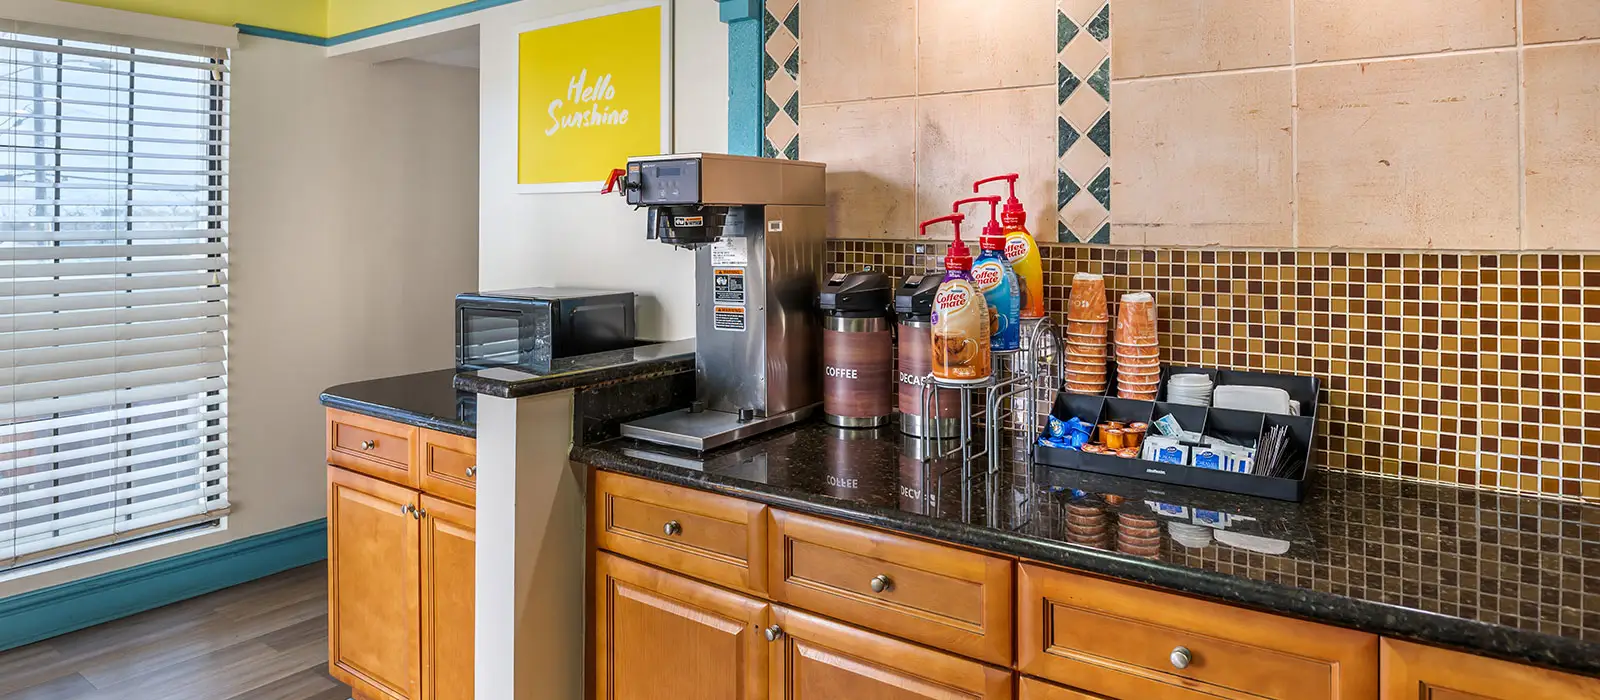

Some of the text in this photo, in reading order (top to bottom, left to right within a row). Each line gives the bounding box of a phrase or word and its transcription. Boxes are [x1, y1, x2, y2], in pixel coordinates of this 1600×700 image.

[567, 68, 615, 104] Hello
[545, 98, 629, 136] Sunshine
[1004, 243, 1025, 254] offee
[971, 269, 998, 280] Coffee
[936, 292, 966, 304] Coffee
[940, 299, 966, 309] mate
[825, 366, 858, 379] COFFEE
